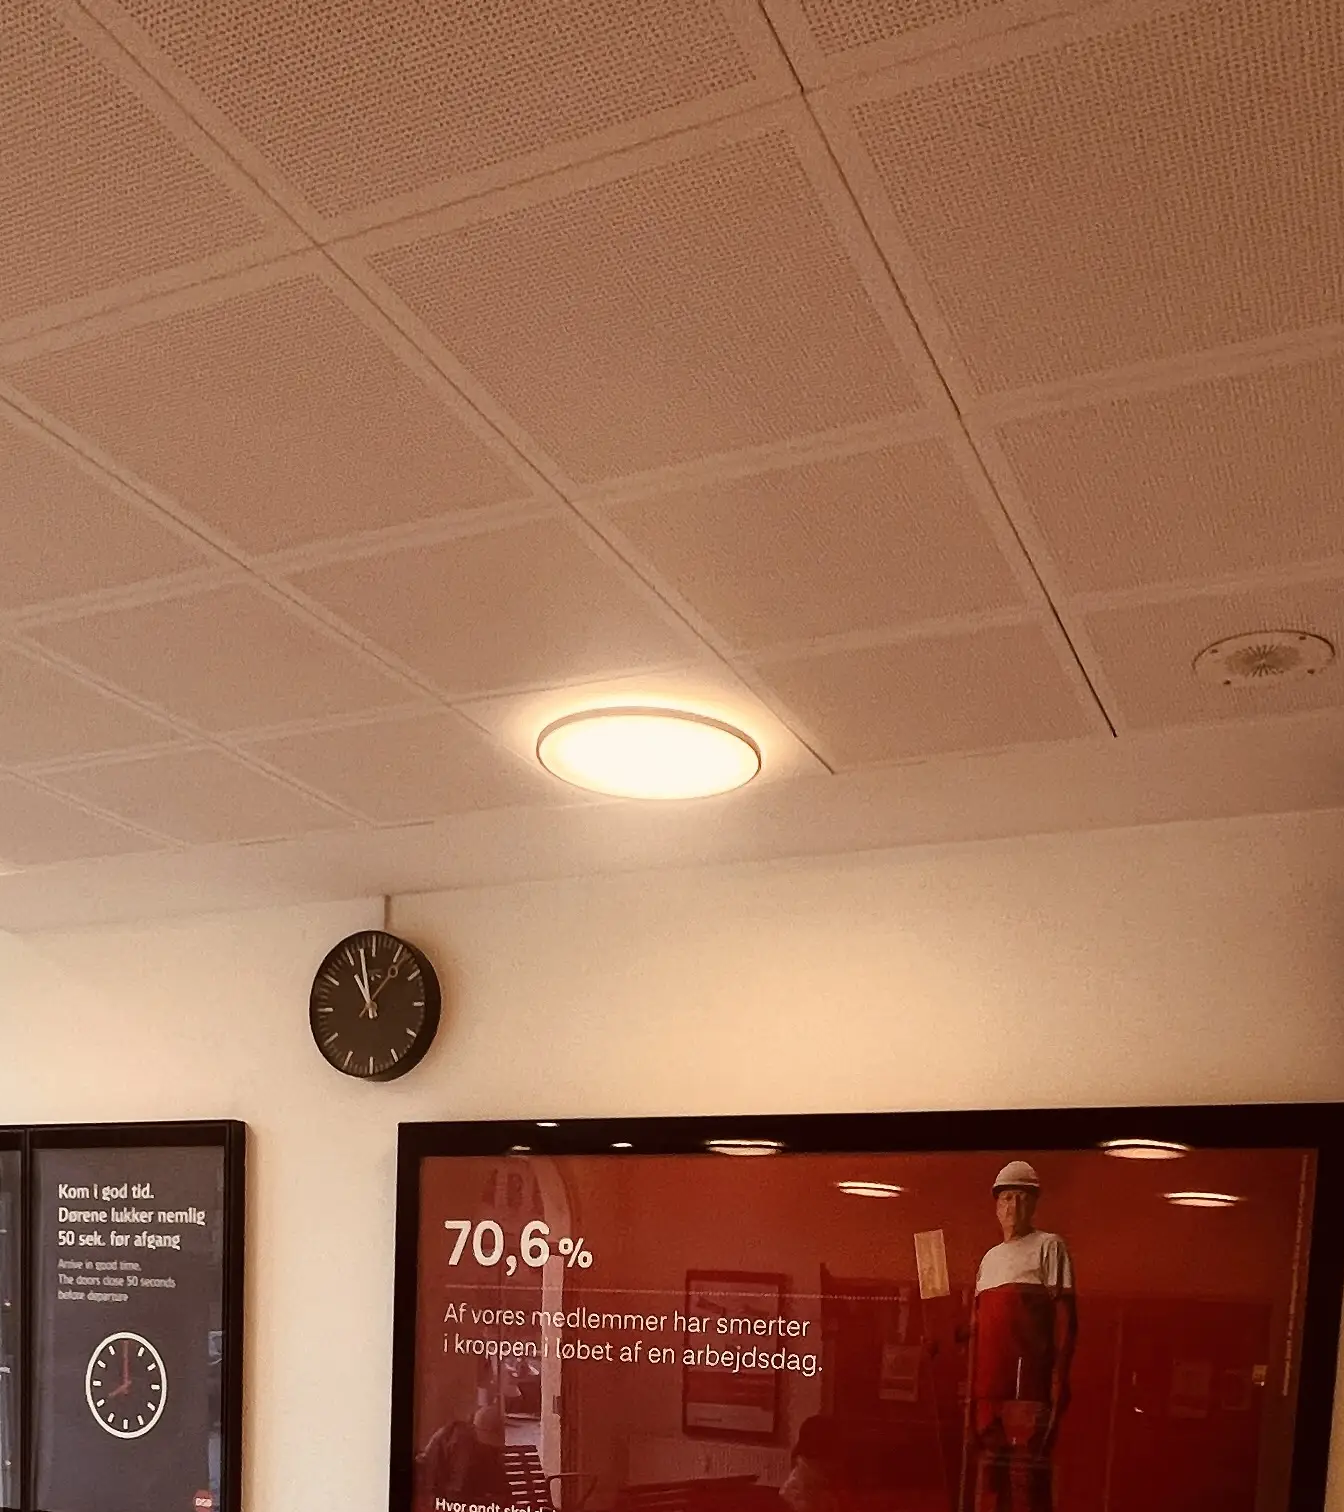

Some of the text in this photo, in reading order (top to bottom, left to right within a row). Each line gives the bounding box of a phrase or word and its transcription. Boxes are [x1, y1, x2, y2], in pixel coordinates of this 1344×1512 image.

[58, 1183, 155, 1201] Kom i god tid.
[58, 1207, 206, 1226] Dørene lukker nemlig
[58, 1230, 181, 1250] 50 sek. før afgang
[58, 1273, 75, 1286] The
[76, 1275, 102, 1287] doors
[126, 1275, 139, 1288] 50
[140, 1276, 177, 1289] seconds
[443, 1302, 811, 1338] Af vores medlemmer har smerter
[443, 1334, 824, 1378] i kroppen i løbet af en arbejdsdag.
